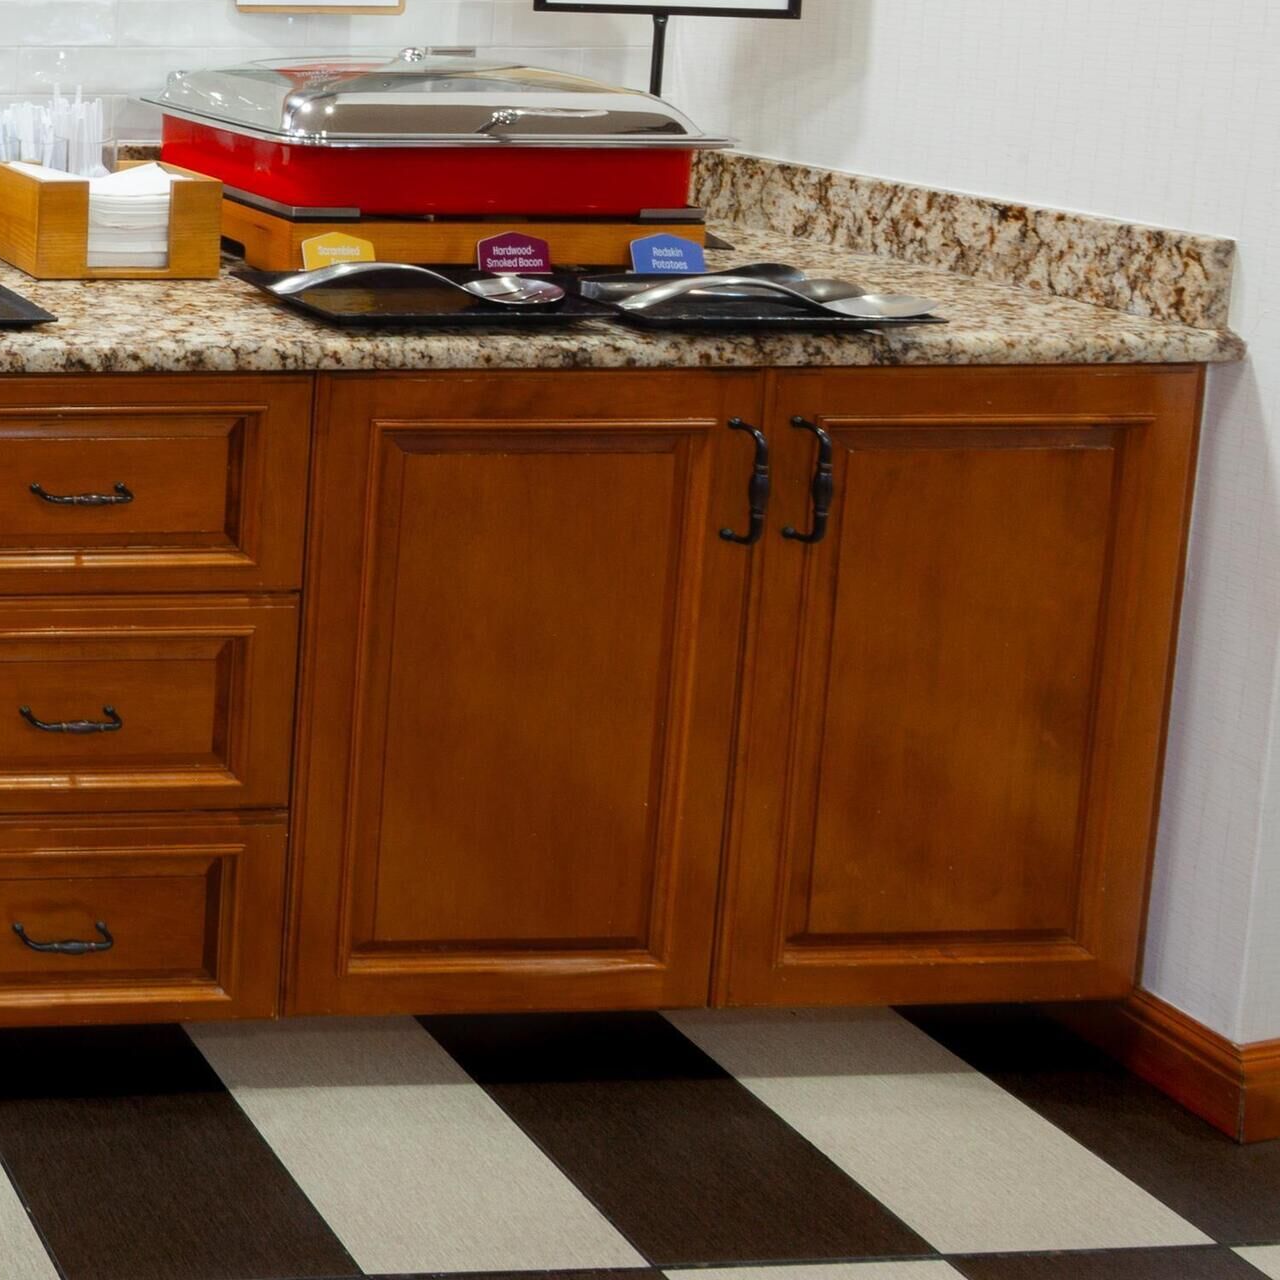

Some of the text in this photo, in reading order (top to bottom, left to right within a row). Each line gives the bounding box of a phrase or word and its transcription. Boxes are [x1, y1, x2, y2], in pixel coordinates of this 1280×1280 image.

[317, 246, 360, 256] Scrambled
[492, 245, 535, 255] Hardwood-
[652, 247, 683, 257] Redskin
[487, 257, 543, 267] Smoked Bacon
[652, 259, 688, 270] Potatoes
